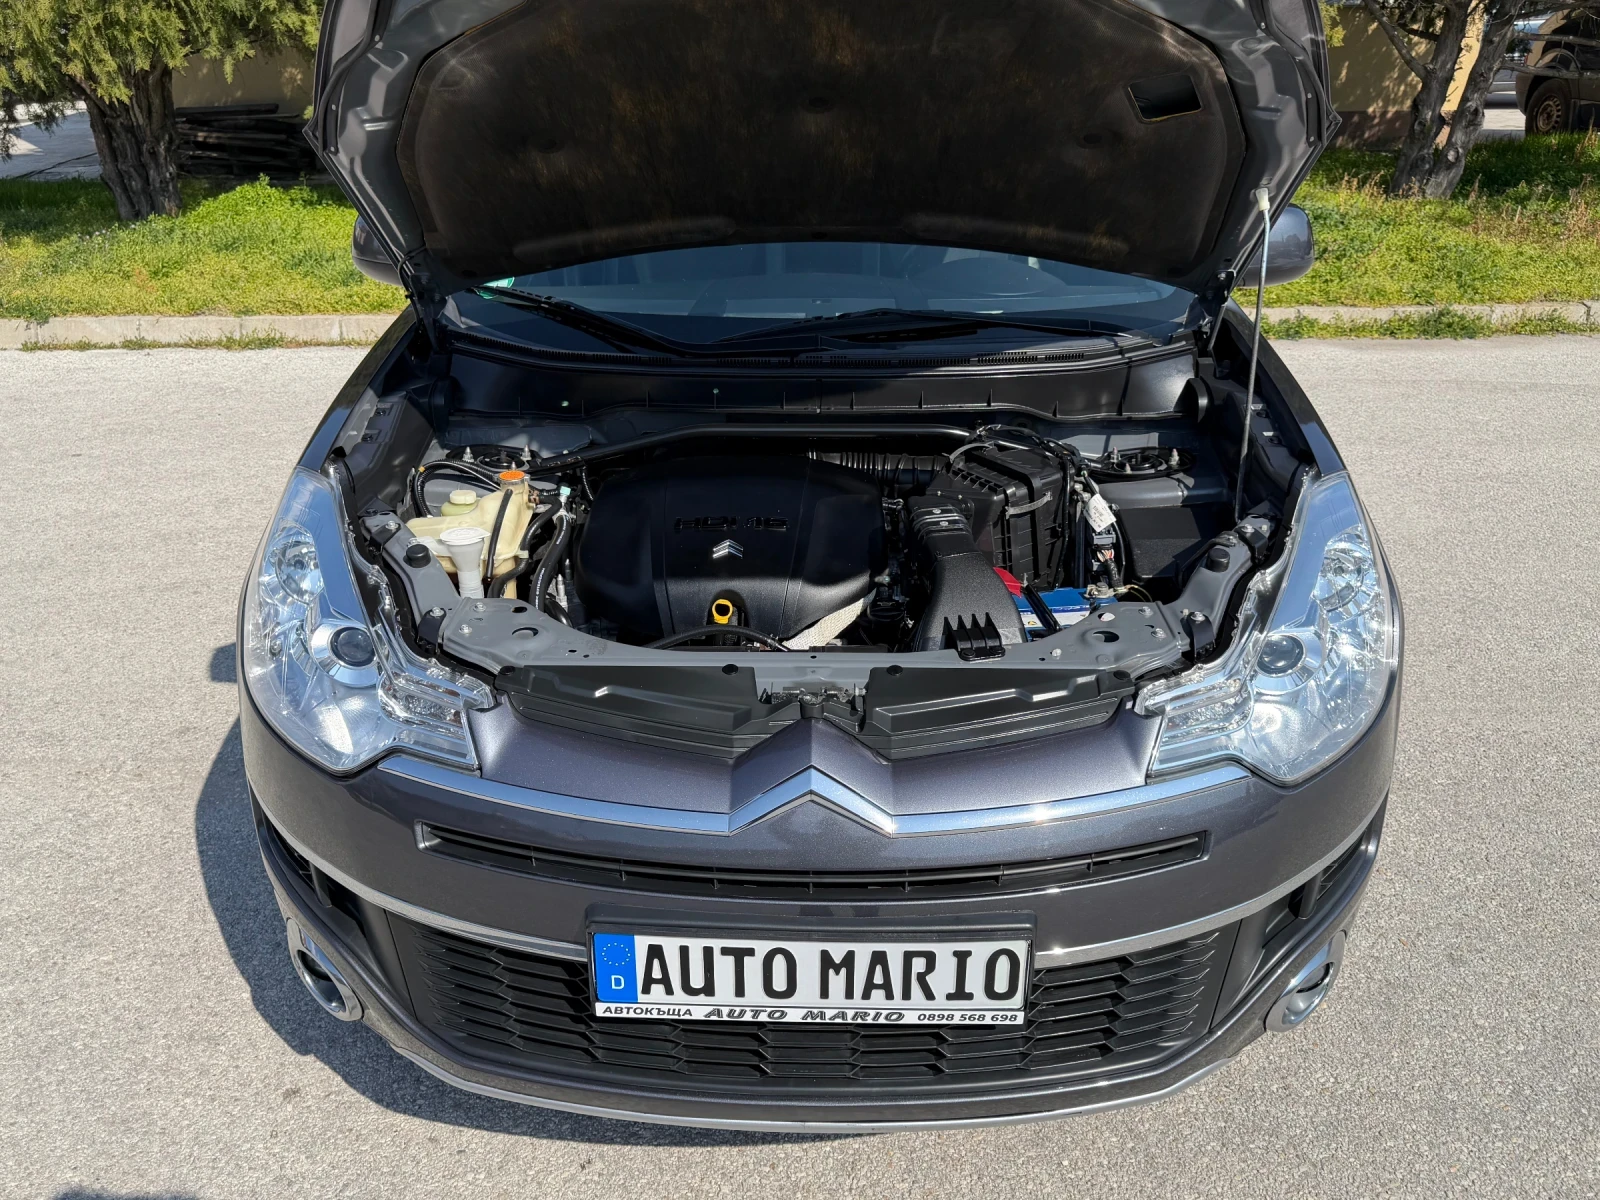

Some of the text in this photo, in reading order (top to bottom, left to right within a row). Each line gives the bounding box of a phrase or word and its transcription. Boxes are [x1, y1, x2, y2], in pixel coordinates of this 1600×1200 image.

[641, 943, 1021, 1001] AUTO MARIO
[611, 975, 625, 990] D
[602, 1005, 1018, 1022] АВТОКЪЩА AUTO MARIO 0898 568 698
